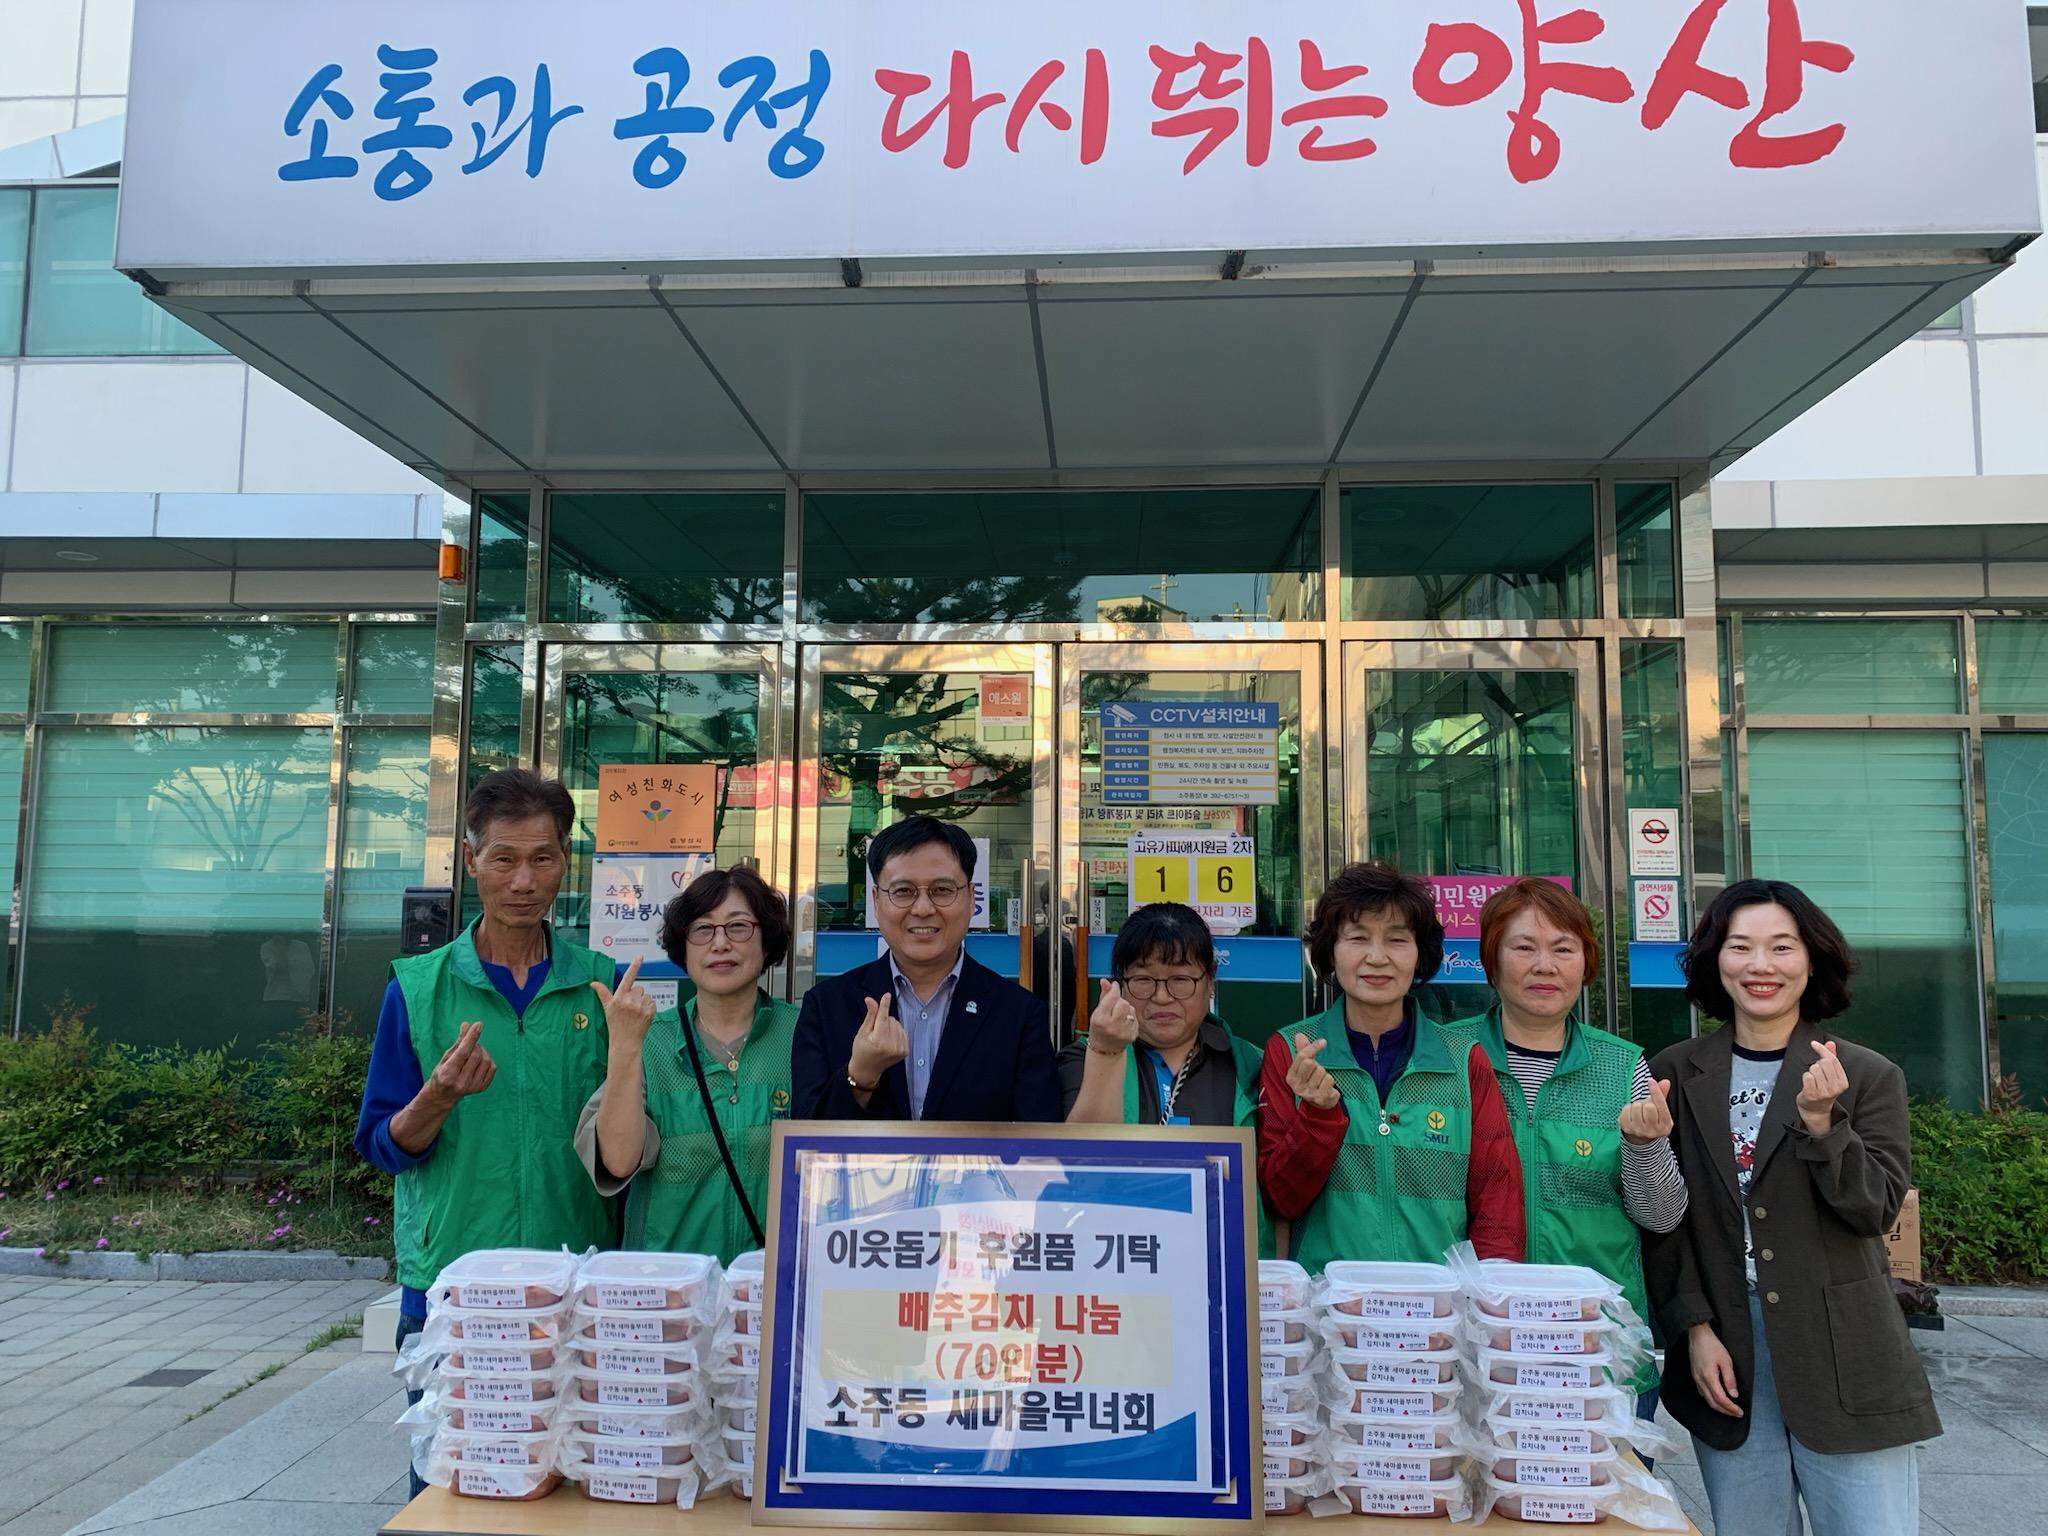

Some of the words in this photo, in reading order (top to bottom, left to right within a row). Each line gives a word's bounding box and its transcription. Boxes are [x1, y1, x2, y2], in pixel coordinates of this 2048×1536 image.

[278, 44, 584, 201] 소통과
[614, 47, 831, 189] 공정
[875, 48, 1109, 168] 다시
[1148, 36, 1388, 176] 뛰는
[1413, 0, 1854, 183] 양산
[1150, 708, 1266, 724] CCTV설치안내
[608, 778, 706, 806] 여성친화도시
[1134, 841, 1227, 854] 고유가피해지원금
[1232, 841, 1252, 854] 2차
[606, 884, 644, 899] 소주동
[1155, 866, 1166, 893] 1
[1217, 866, 1233, 894] 6
[1232, 906, 1253, 918] 기준
[1729, 1088, 1766, 1108] et's
[1424, 1132, 1449, 1145] SMU
[826, 1228, 957, 1271] 이웃돕기
[976, 1231, 1076, 1271] 후원품
[1094, 1233, 1160, 1274] 기탁
[897, 1291, 1034, 1334] 배추김치
[1054, 1295, 1121, 1336] 나눔
[934, 1342, 1084, 1385] (70인분)
[824, 1386, 928, 1429] 소주동
[946, 1389, 1157, 1434] 새마을부녀회
